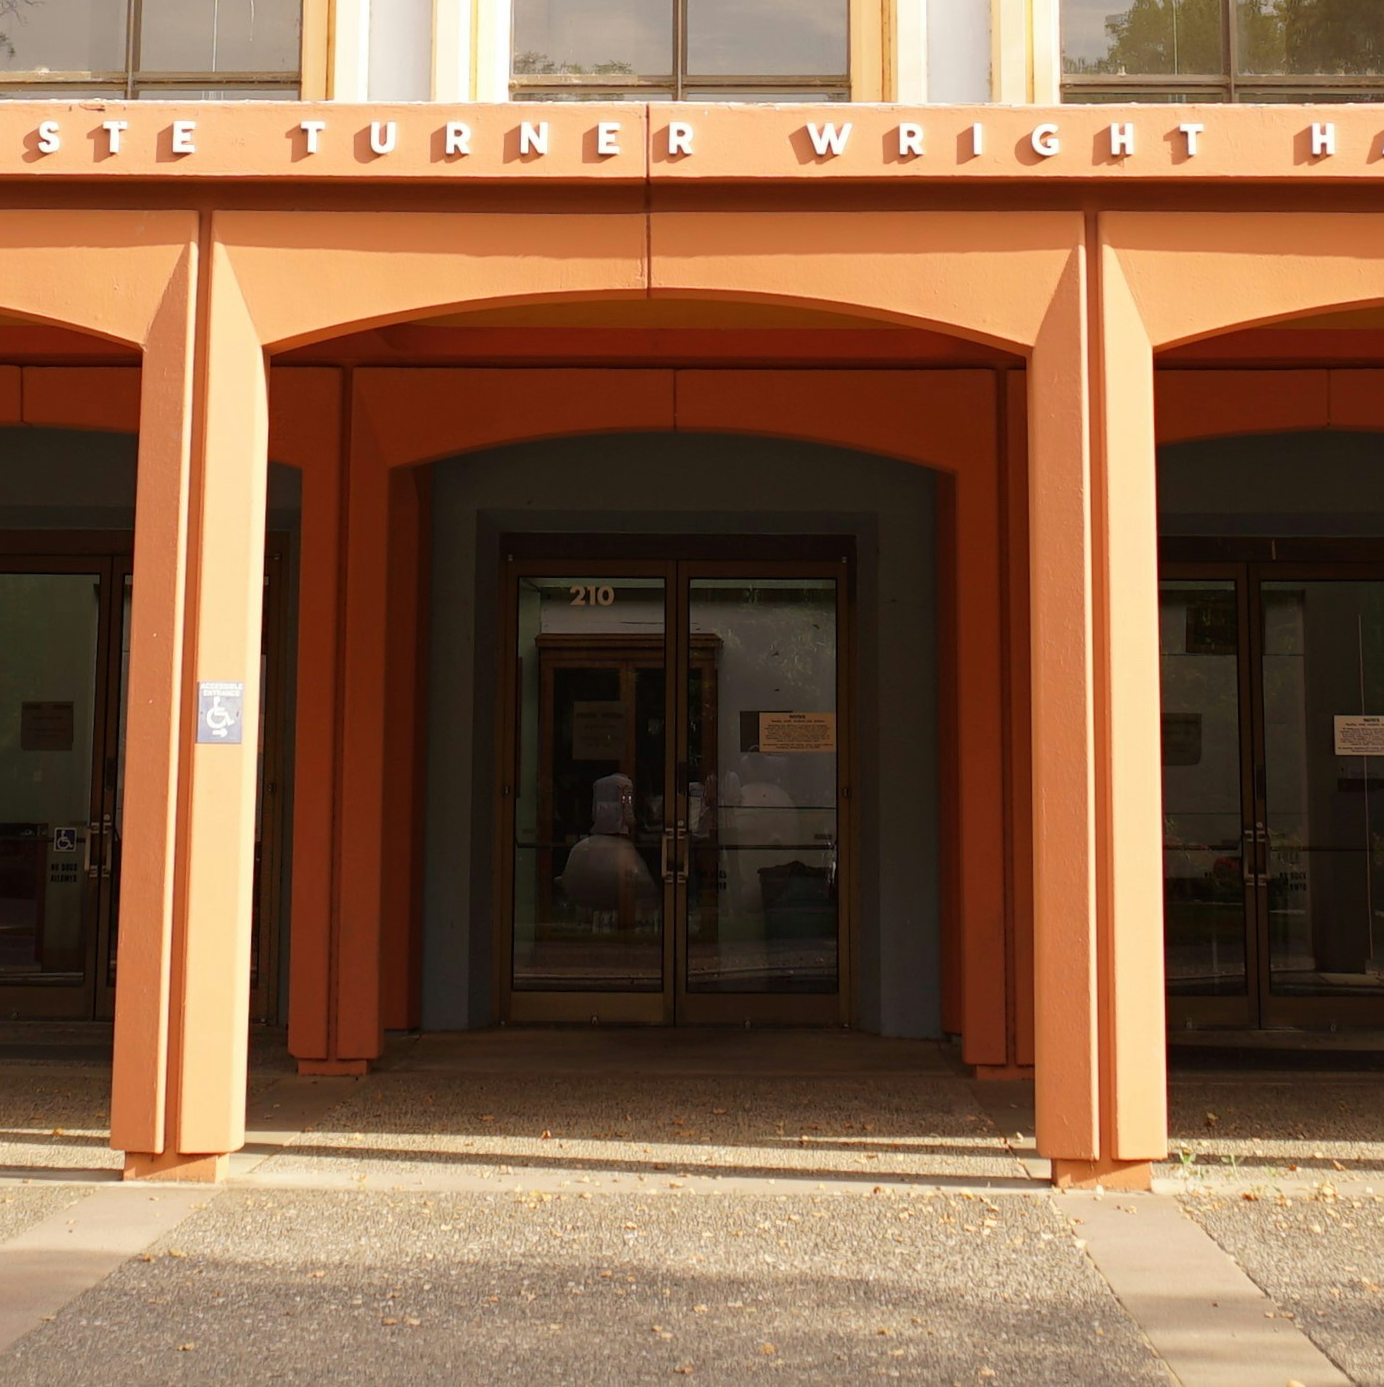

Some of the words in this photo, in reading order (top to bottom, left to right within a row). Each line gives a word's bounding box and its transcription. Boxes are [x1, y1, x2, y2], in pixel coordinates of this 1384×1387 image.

[300, 120, 695, 155] TURNER
[806, 122, 1206, 156] WRIGHT
[569, 585, 615, 606] 210
